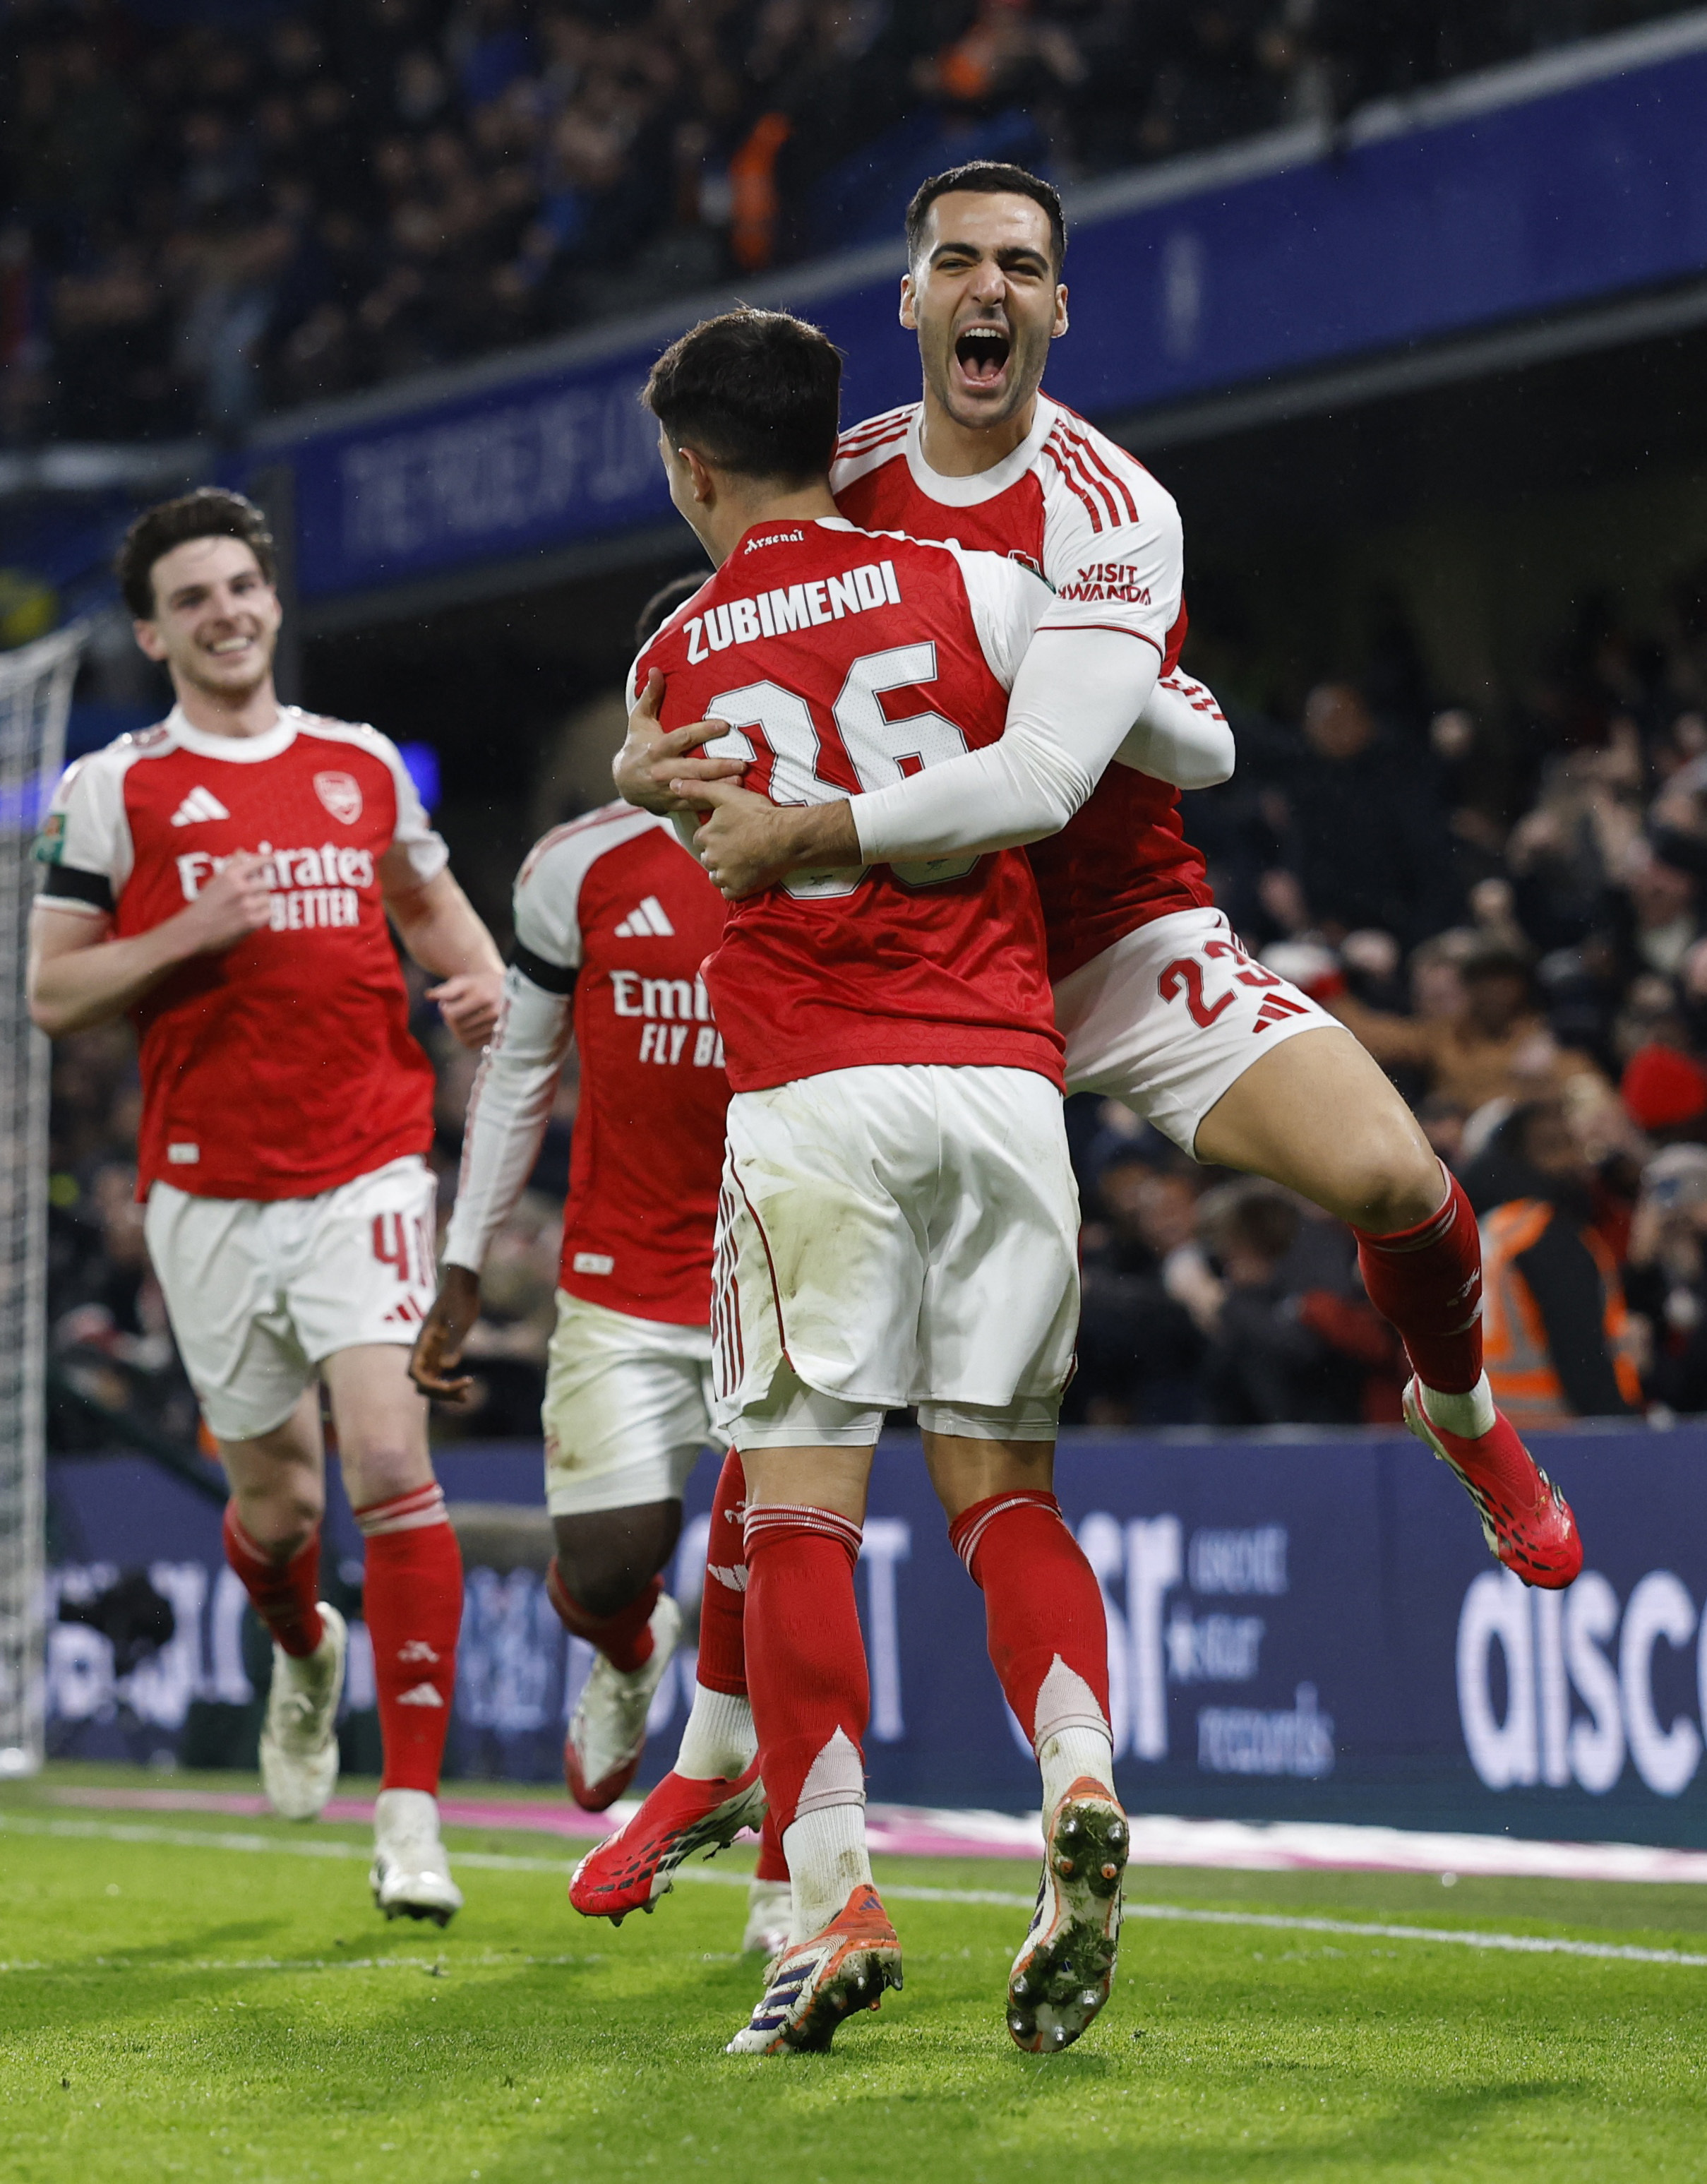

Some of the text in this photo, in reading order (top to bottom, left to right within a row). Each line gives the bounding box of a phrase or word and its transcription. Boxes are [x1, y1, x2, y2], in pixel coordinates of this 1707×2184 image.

[744, 529, 804, 555] Arsenal
[1077, 563, 1137, 584] VISIT
[683, 560, 902, 666] ZUBIMENDI
[609, 969, 716, 1021] Emi
[1157, 940, 1283, 1030] 23
[639, 1022, 689, 1066] FLY
